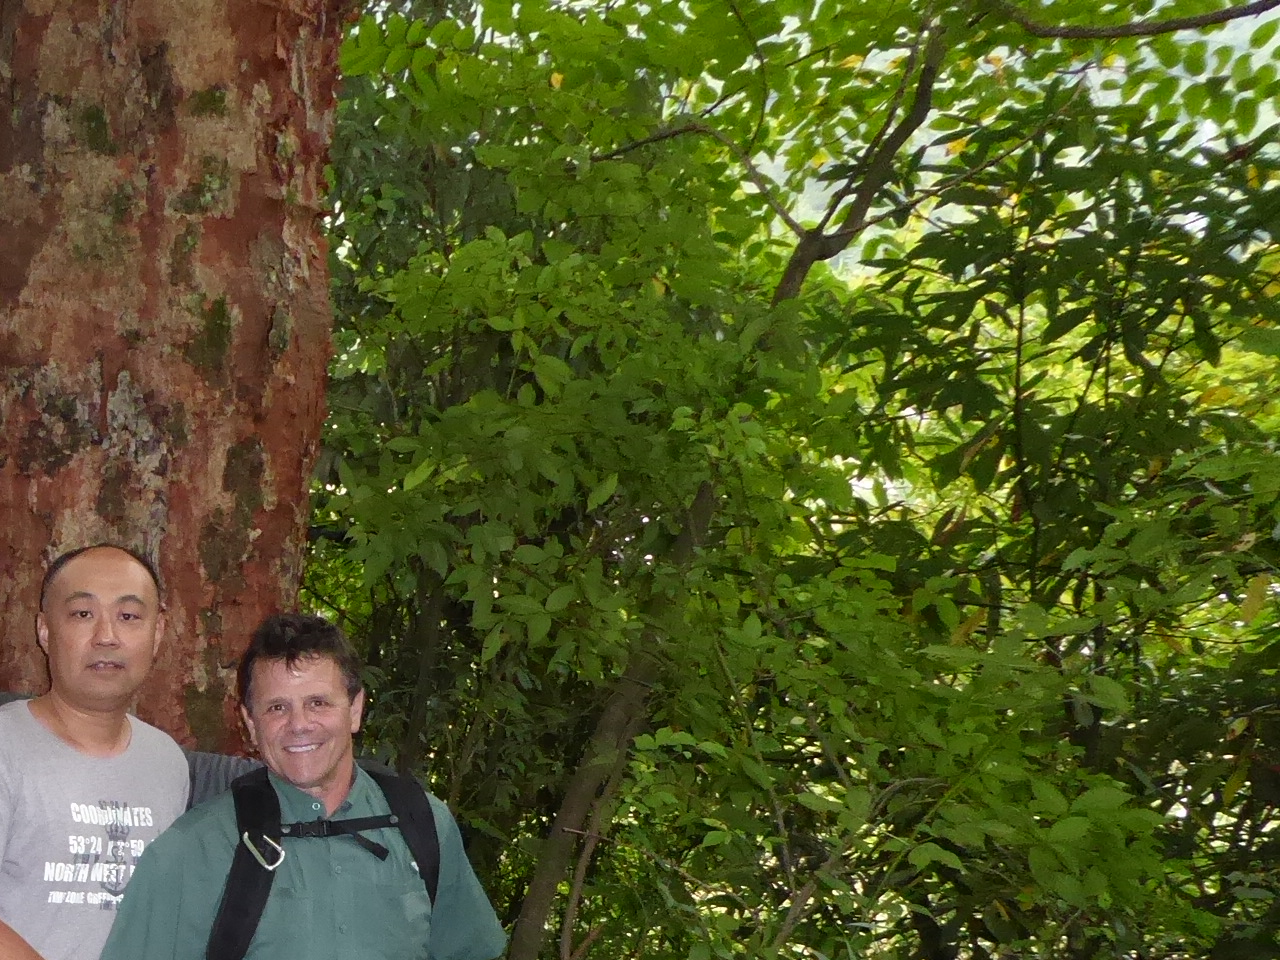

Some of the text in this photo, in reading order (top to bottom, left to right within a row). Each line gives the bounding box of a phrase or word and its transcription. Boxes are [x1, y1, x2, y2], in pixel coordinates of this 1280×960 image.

[70, 802, 153, 827] COORDINATES
[43, 861, 90, 883] NORTH
[90, 862, 126, 884] WEST
